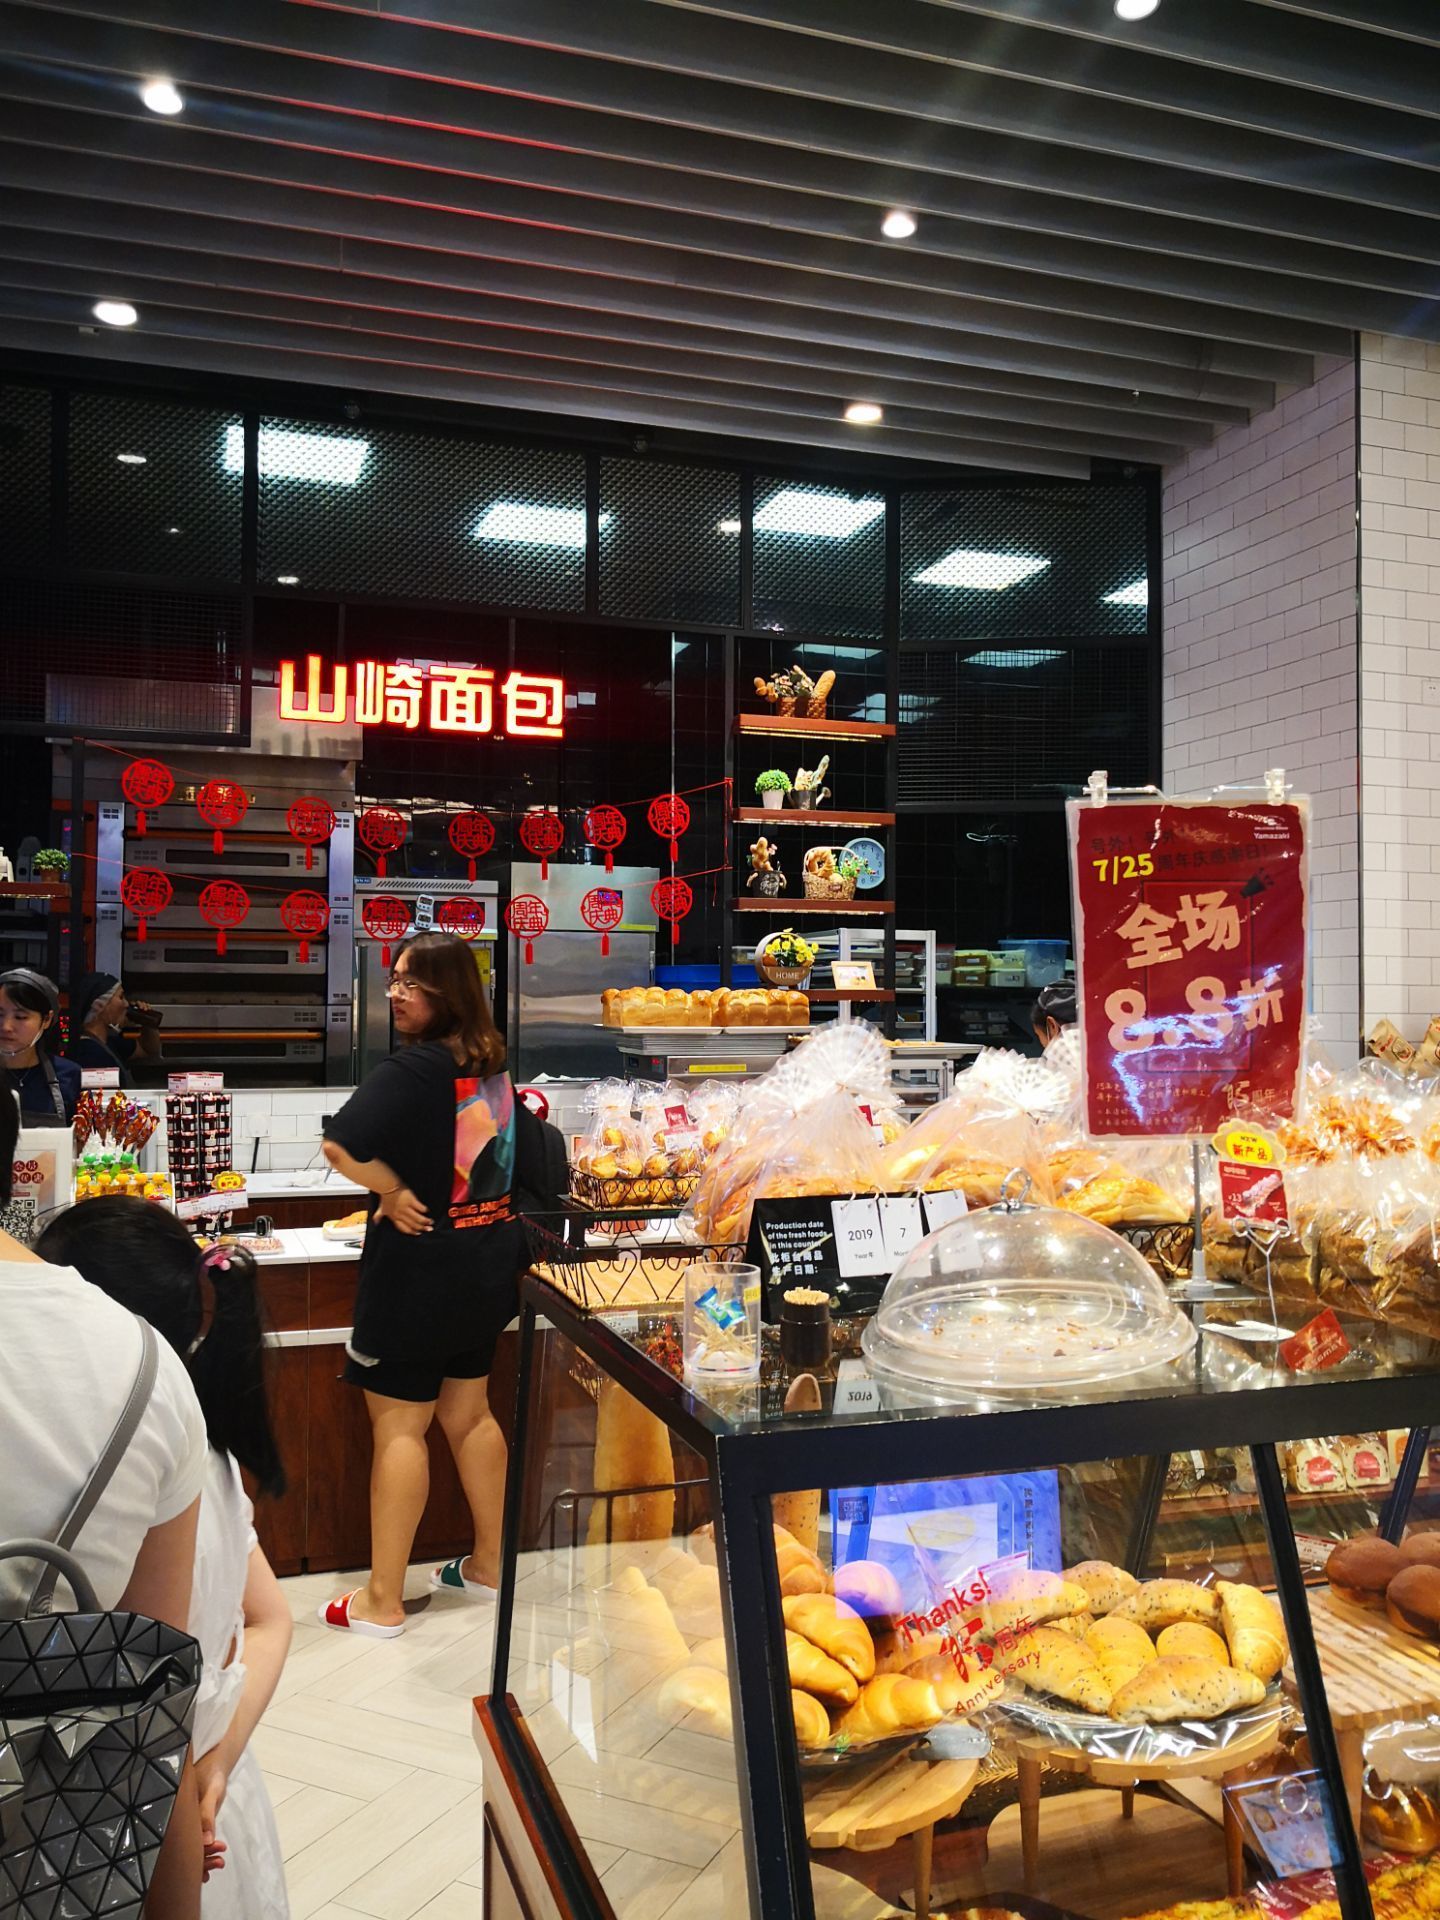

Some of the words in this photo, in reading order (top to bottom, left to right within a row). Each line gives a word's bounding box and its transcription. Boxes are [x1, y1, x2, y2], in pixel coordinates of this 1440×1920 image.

[280, 654, 564, 738] 山崎面包
[1254, 832, 1290, 841] Yamazaki
[1092, 853, 1154, 885] 7/25
[1116, 890, 1241, 969] 全场
[776, 971, 799, 980] HOME
[1104, 975, 1285, 1051] 8.8折
[1233, 1143, 1268, 1161] 新产品
[766, 1221, 807, 1230] Production
[900, 1228, 906, 1238] 7
[767, 1232, 775, 1240] of
[788, 1231, 806, 1239] fresh
[807, 1230, 827, 1238] foods
[848, 1229, 873, 1241] 2019
[770, 1250, 823, 1263] 此柜台商品
[894, 1570, 992, 1643] Thanks!
[954, 1651, 1041, 1714] Anniversary
